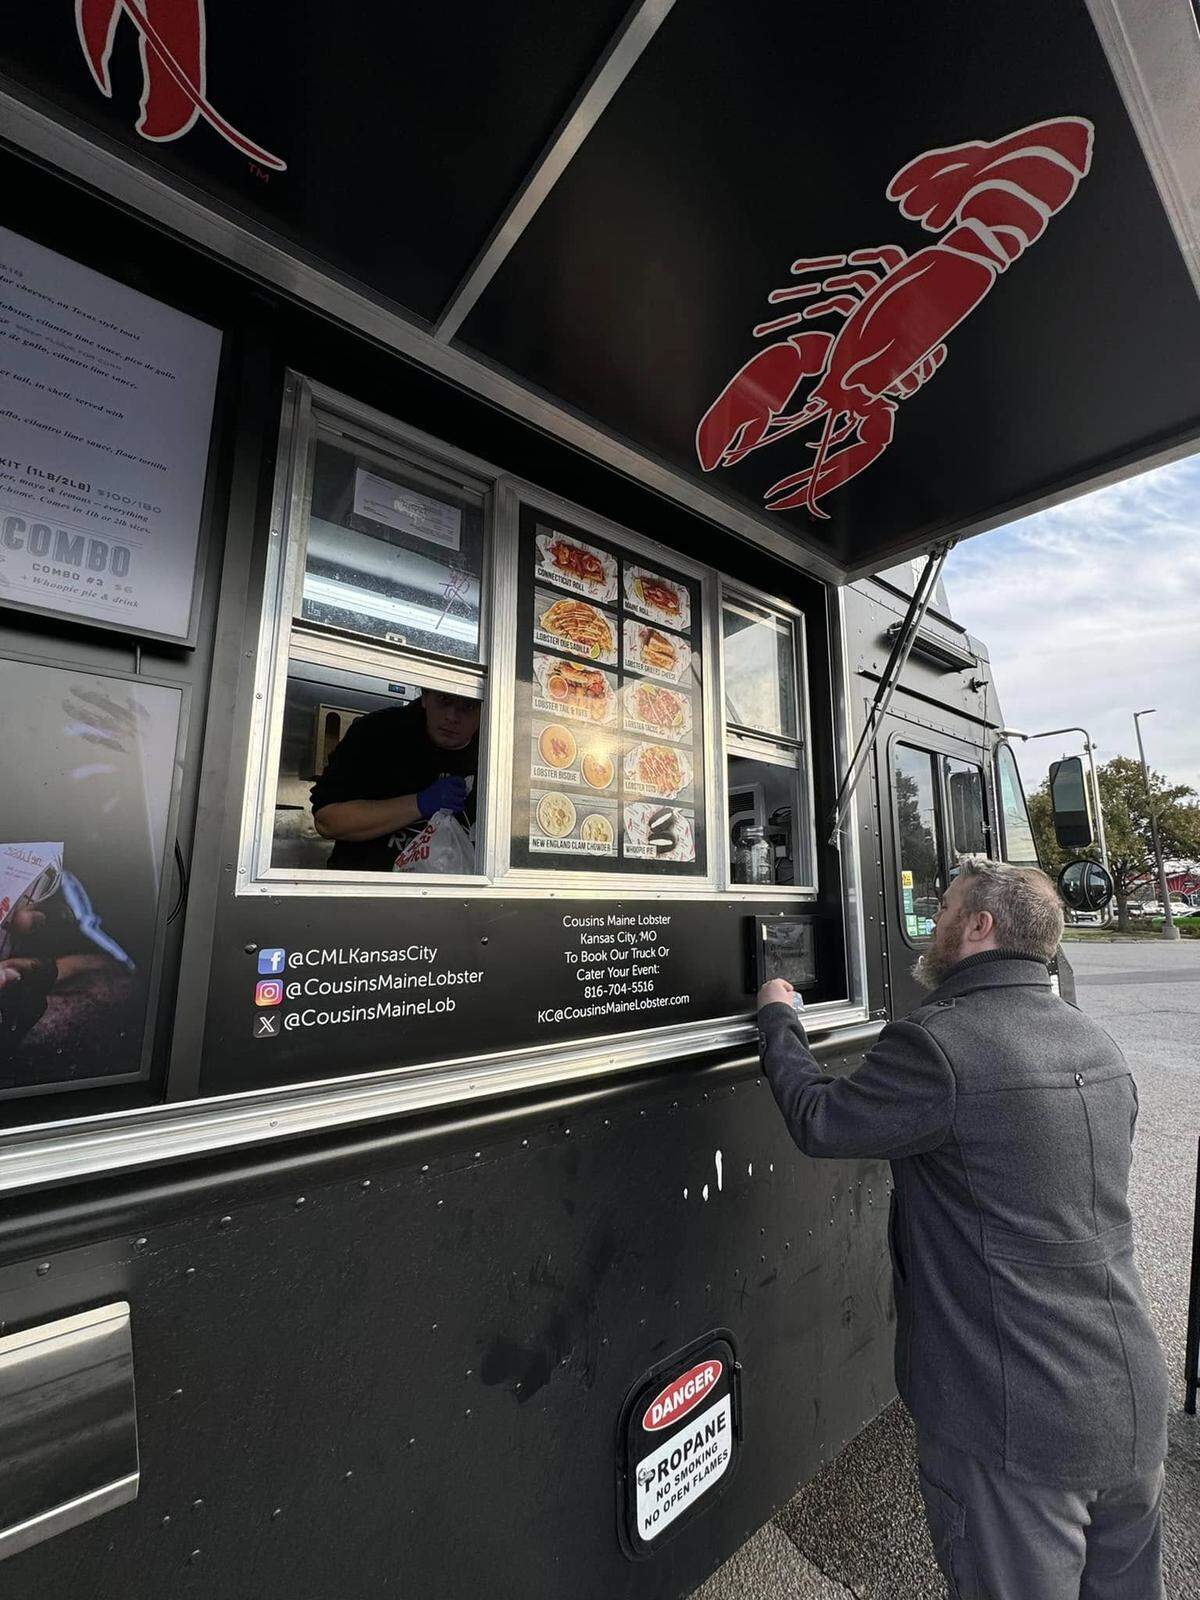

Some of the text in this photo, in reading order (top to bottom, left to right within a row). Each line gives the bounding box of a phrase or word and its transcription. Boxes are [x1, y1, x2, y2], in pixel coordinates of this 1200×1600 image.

[72, 307, 97, 321] Texas
[99, 318, 119, 330] style
[120, 328, 141, 341] toast
[36, 317, 73, 336] cilantro
[74, 333, 95, 346] lime
[124, 354, 144, 366] pico
[144, 361, 155, 370] de
[155, 367, 177, 381] gallo
[52, 350, 89, 369] cilantro
[90, 365, 110, 377] lime
[35, 381, 46, 391] in
[75, 397, 105, 411] served
[106, 408, 125, 420] with
[24, 417, 62, 435] cilantro
[63, 431, 85, 442] lime
[87, 439, 113, 454] sauce,
[115, 448, 137, 462] flour
[139, 456, 169, 472] tortilla
[0, 457, 21, 470] KIT
[27, 466, 92, 493] (1LB/2LB)
[19, 477, 46, 490] mayo
[59, 489, 92, 505] lemons
[103, 504, 150, 523] everything
[40, 496, 71, 510] Comes
[73, 506, 83, 514] in
[101, 514, 111, 522] or
[2, 515, 132, 578] COMBO
[32, 562, 81, 581] COMBO
[537, 567, 585, 592] CONNECTICUT ROLL
[32, 576, 79, 594] Whoopie
[80, 589, 98, 600] pie
[111, 596, 140, 608] drink
[639, 604, 650, 616] ROLL
[536, 631, 590, 655] LOBSTER QUESADILLA
[625, 659, 644, 671] LOBSTER
[535, 698, 558, 711] LOBSTER
[534, 767, 577, 782] LOBSTER BISQUE
[532, 839, 611, 852] NEW ENGLAND CLAM CHOWDER
[563, 914, 671, 928] Cousins Maine Lobster
[580, 930, 657, 945] Kansas City, MO
[288, 945, 438, 969] @CMLKansasCity
[565, 946, 670, 964] To Book Our Truck Or
[286, 969, 484, 1000] @CousinsMaineLobster
[576, 964, 660, 982] Cater Your Event:
[584, 980, 654, 999] 816-704-5516
[284, 997, 456, 1030] @CousinsMaineLob
[537, 994, 690, 1023] KC@CousinsMaineLobster.com
[651, 1366, 715, 1426] DANGER
[644, 1410, 727, 1494] PROPANE
[656, 1442, 718, 1502] NO SMOKING
[644, 1448, 728, 1531] NO OPEN FLAMES
